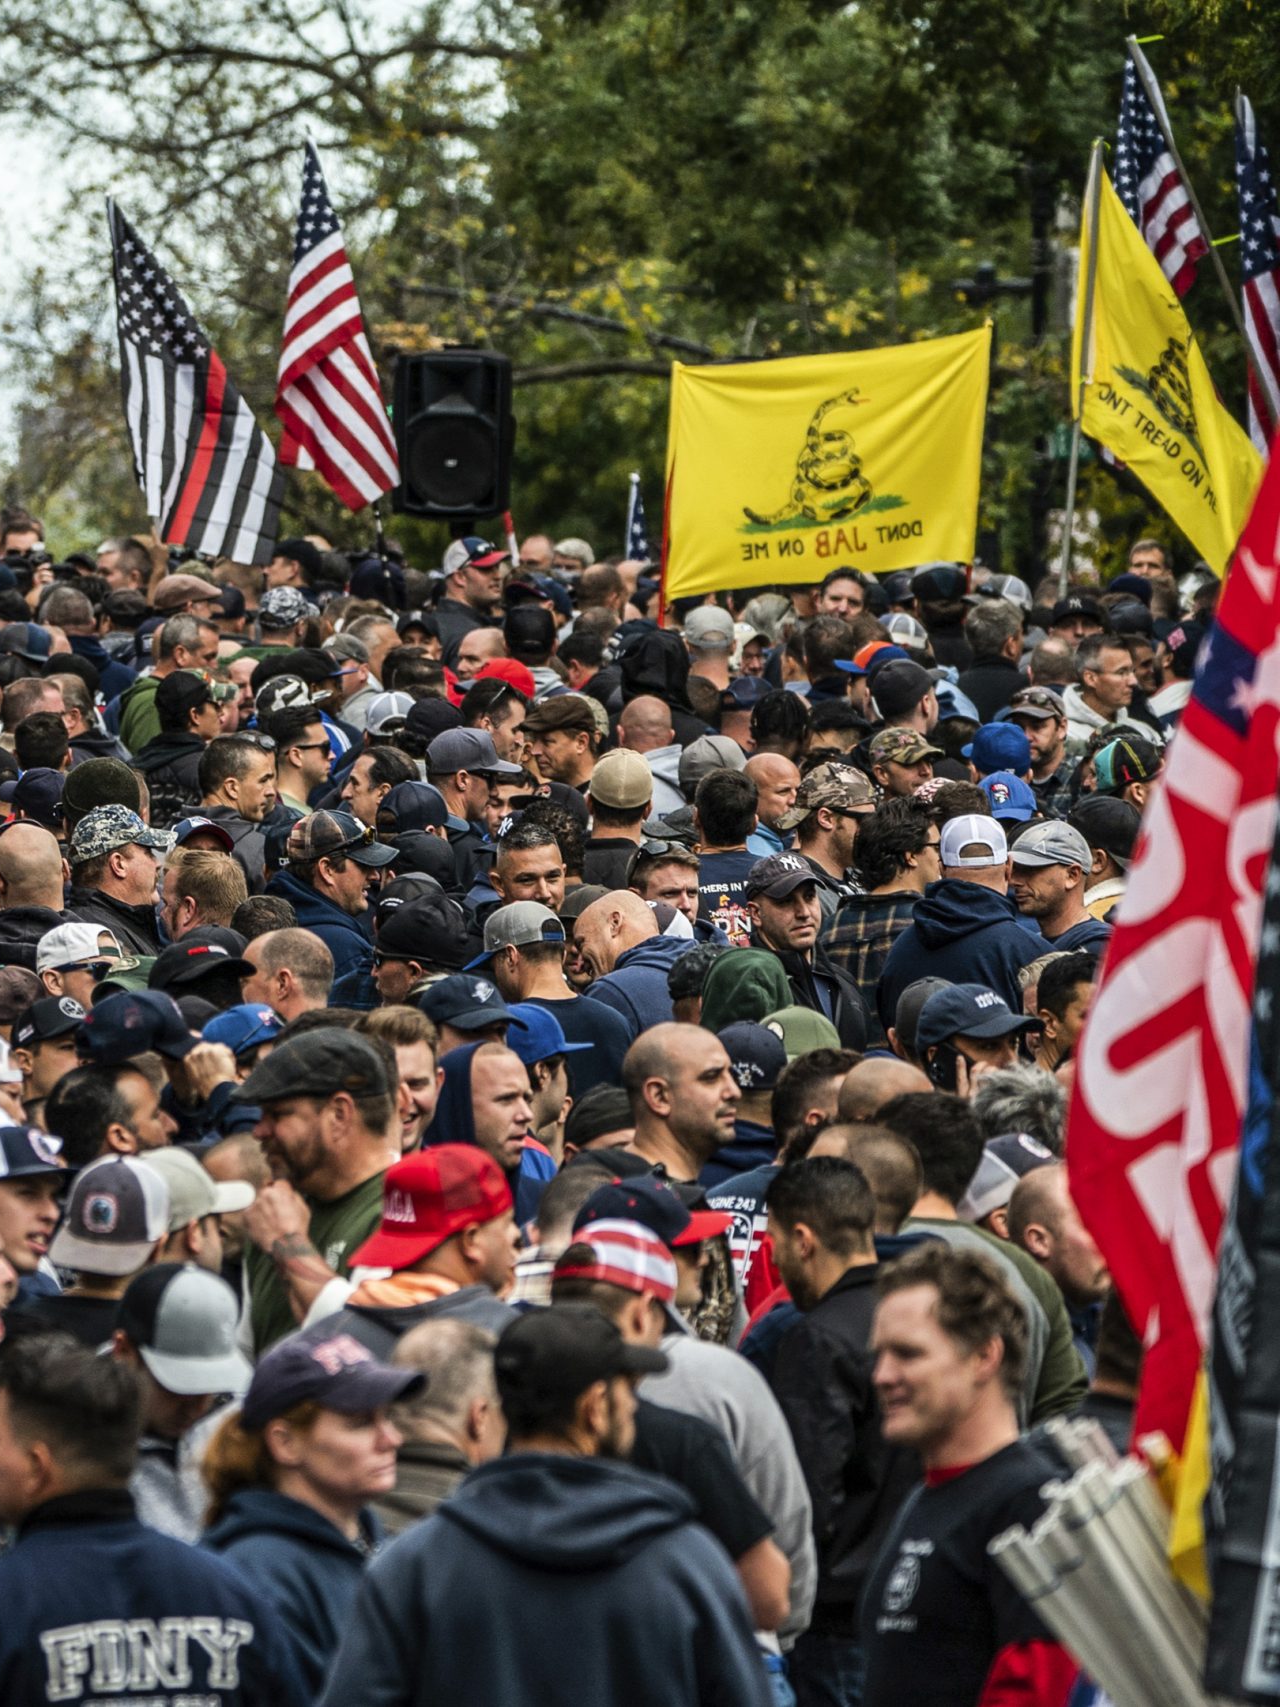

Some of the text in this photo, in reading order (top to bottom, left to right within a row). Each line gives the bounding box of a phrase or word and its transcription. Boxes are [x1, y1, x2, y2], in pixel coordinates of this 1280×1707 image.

[1097, 382, 1134, 416] ONT
[1134, 411, 1181, 458] TREAD
[1181, 459, 1203, 488] ON
[779, 855, 802, 871] NY
[734, 1197, 757, 1212] 243
[38, 1614, 255, 1702] FDNY
